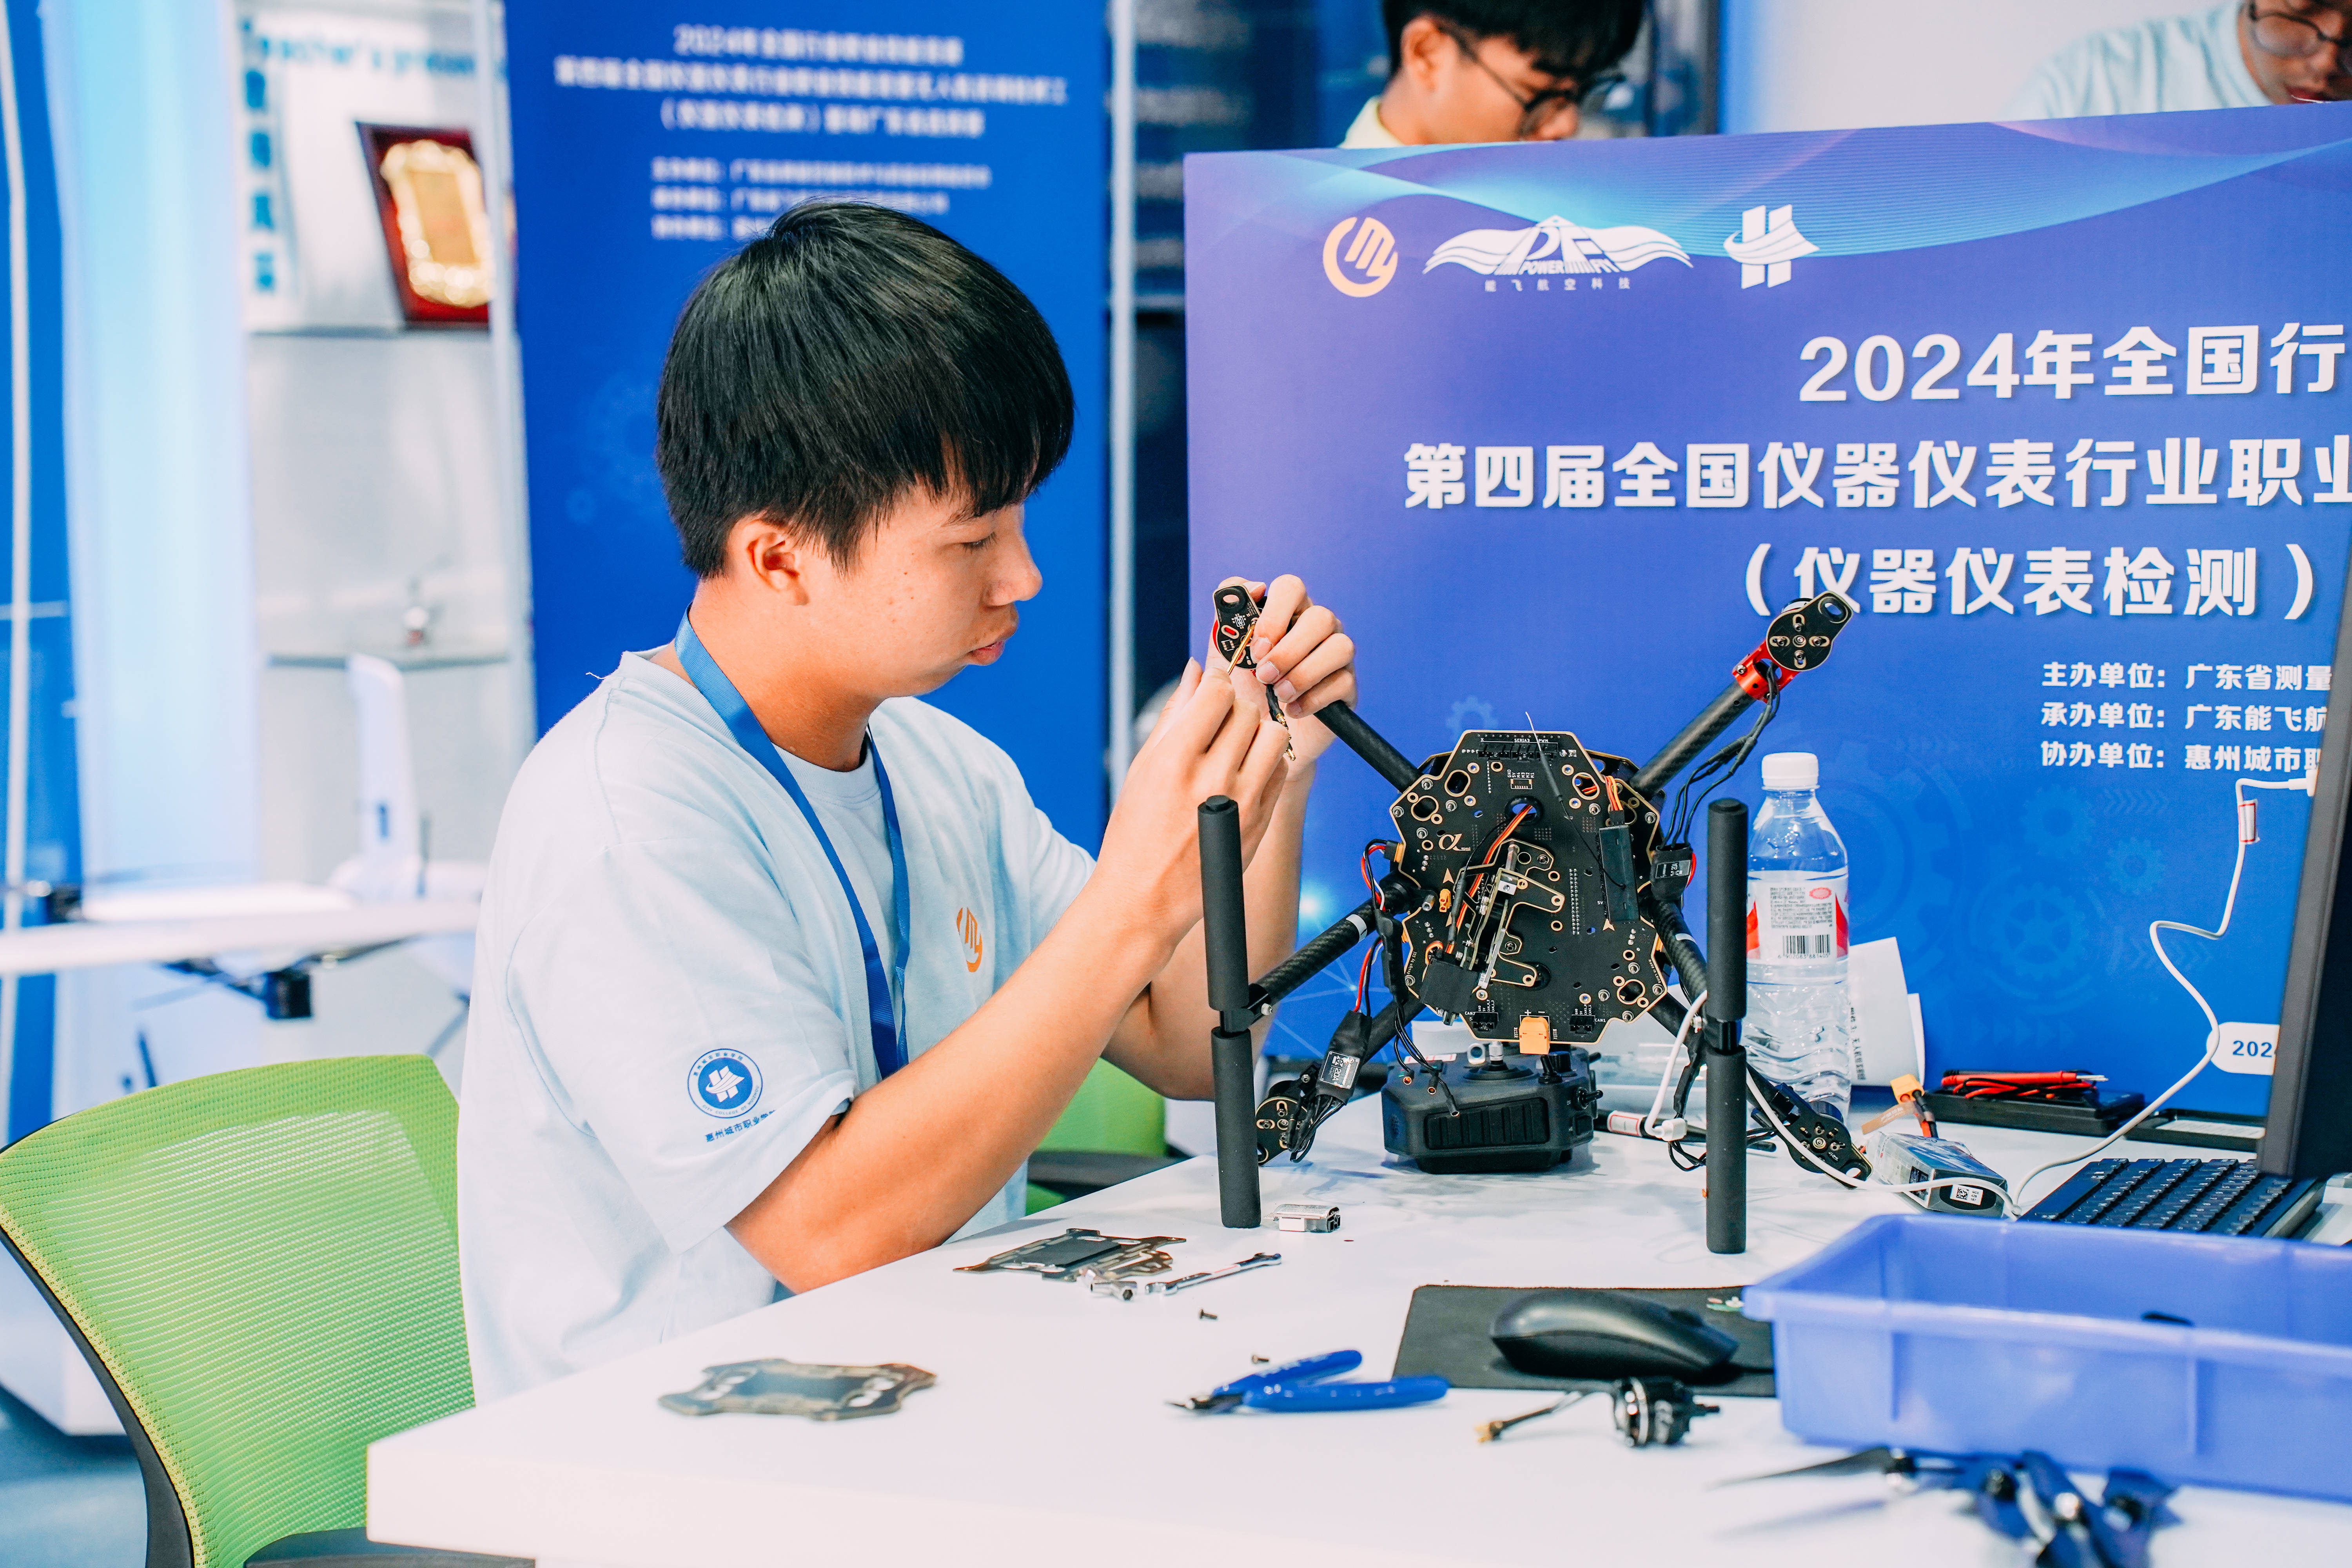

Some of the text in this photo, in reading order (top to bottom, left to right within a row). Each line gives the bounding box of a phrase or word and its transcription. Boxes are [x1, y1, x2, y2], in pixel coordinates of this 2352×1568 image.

[1799, 323, 2345, 401] 2024年全国行
[2042, 661, 2332, 691] 主办单位： 广东省测量
[2041, 701, 2165, 729] 承办单位：
[2040, 740, 2165, 769] 协办单位：
[2232, 1040, 2277, 1058] 202
[1332, 1068, 1341, 1081] 20A
[704, 1110, 777, 1142] 惠州城市职业学
